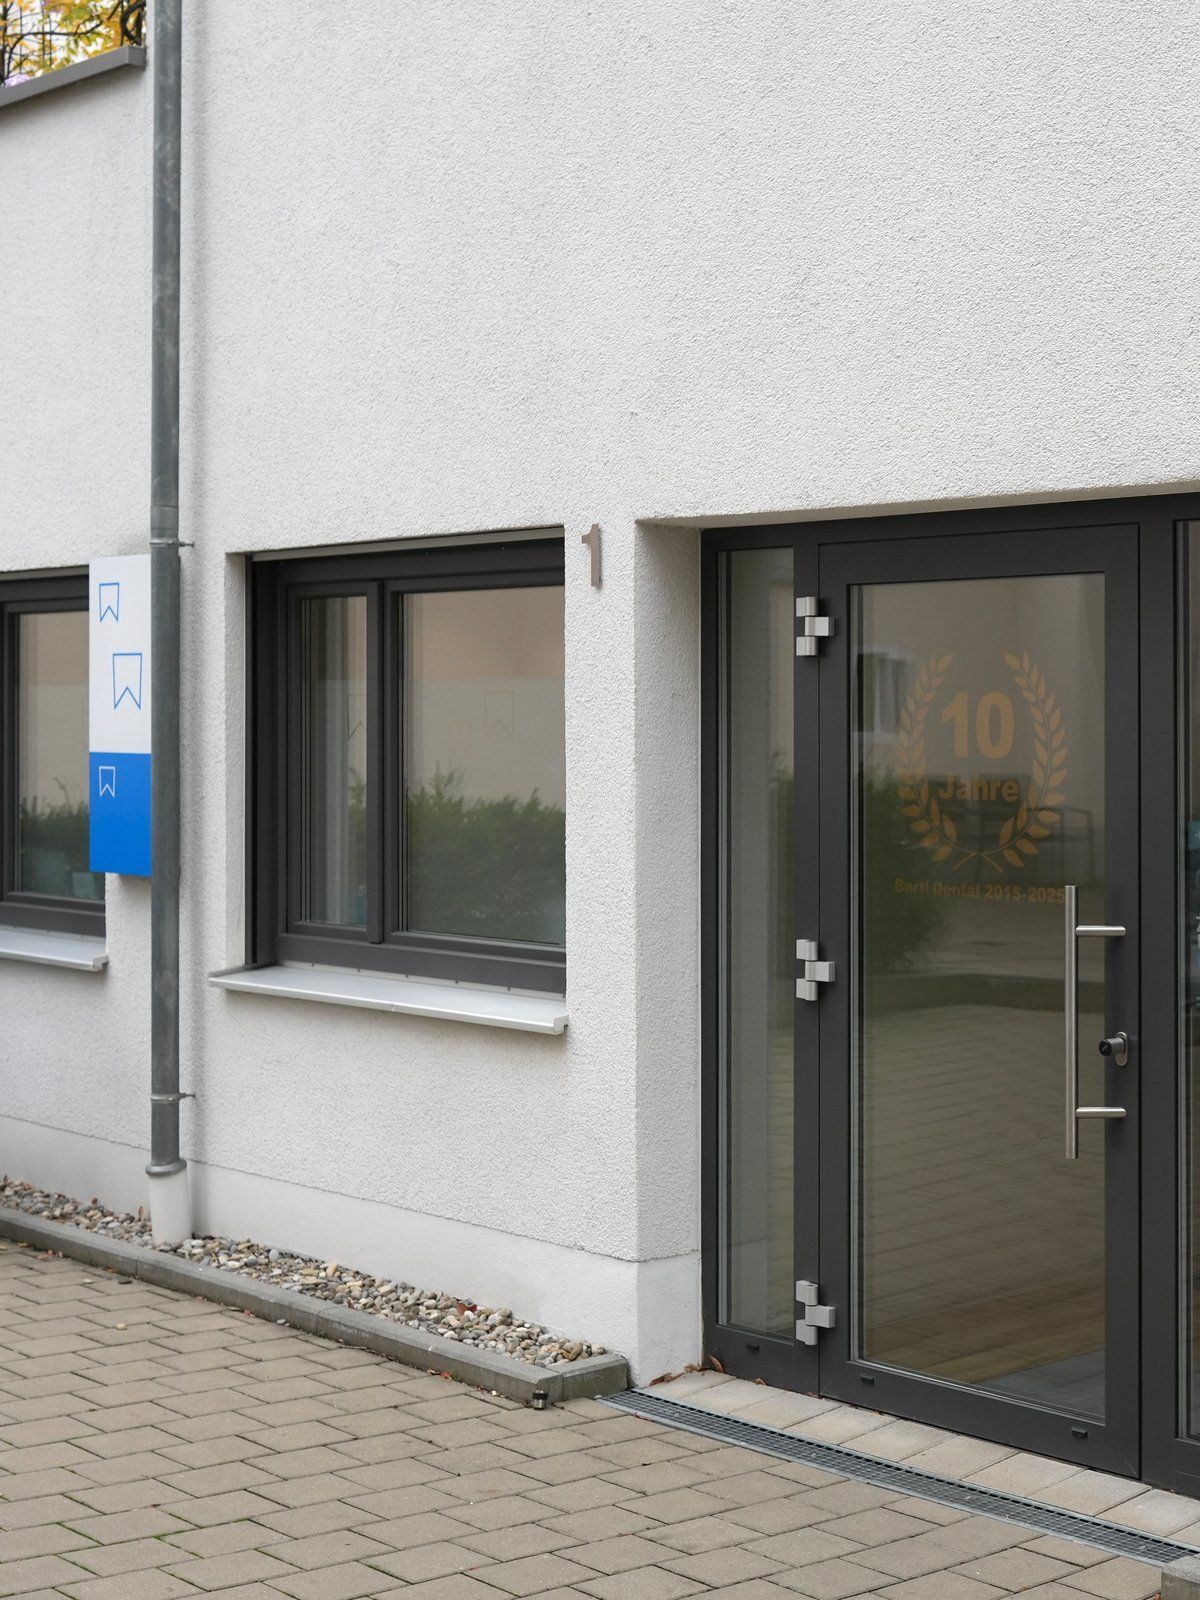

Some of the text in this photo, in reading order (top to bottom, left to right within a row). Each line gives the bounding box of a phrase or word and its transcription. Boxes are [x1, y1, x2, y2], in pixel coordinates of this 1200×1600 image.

[581, 523, 602, 588] 1
[940, 691, 1015, 760] 10
[938, 773, 1020, 801] Jahre
[895, 878, 929, 895] Bartl
[933, 881, 980, 898] Dental
